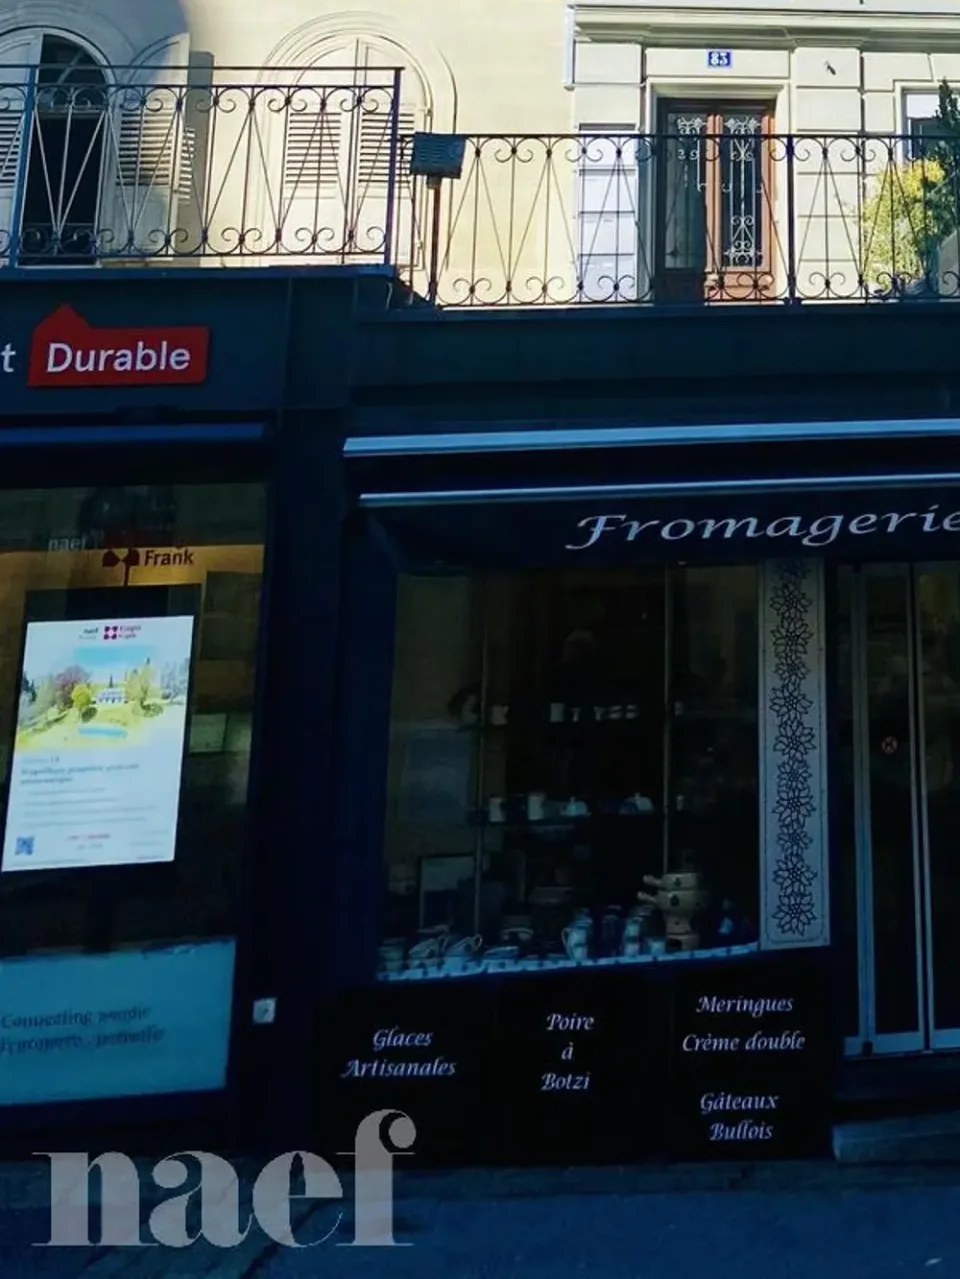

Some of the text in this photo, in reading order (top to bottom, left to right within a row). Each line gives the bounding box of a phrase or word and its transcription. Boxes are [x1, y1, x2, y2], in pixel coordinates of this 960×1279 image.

[47, 341, 190, 372] Durable
[145, 549, 194, 567] Frank
[696, 995, 793, 1018] Meringues
[546, 1012, 595, 1031] Poire
[372, 1025, 433, 1051] Glaces
[744, 1030, 806, 1051] double
[340, 1056, 457, 1078] Artisanales
[541, 1071, 592, 1091] Botzi
[709, 1119, 774, 1141] Bullois
